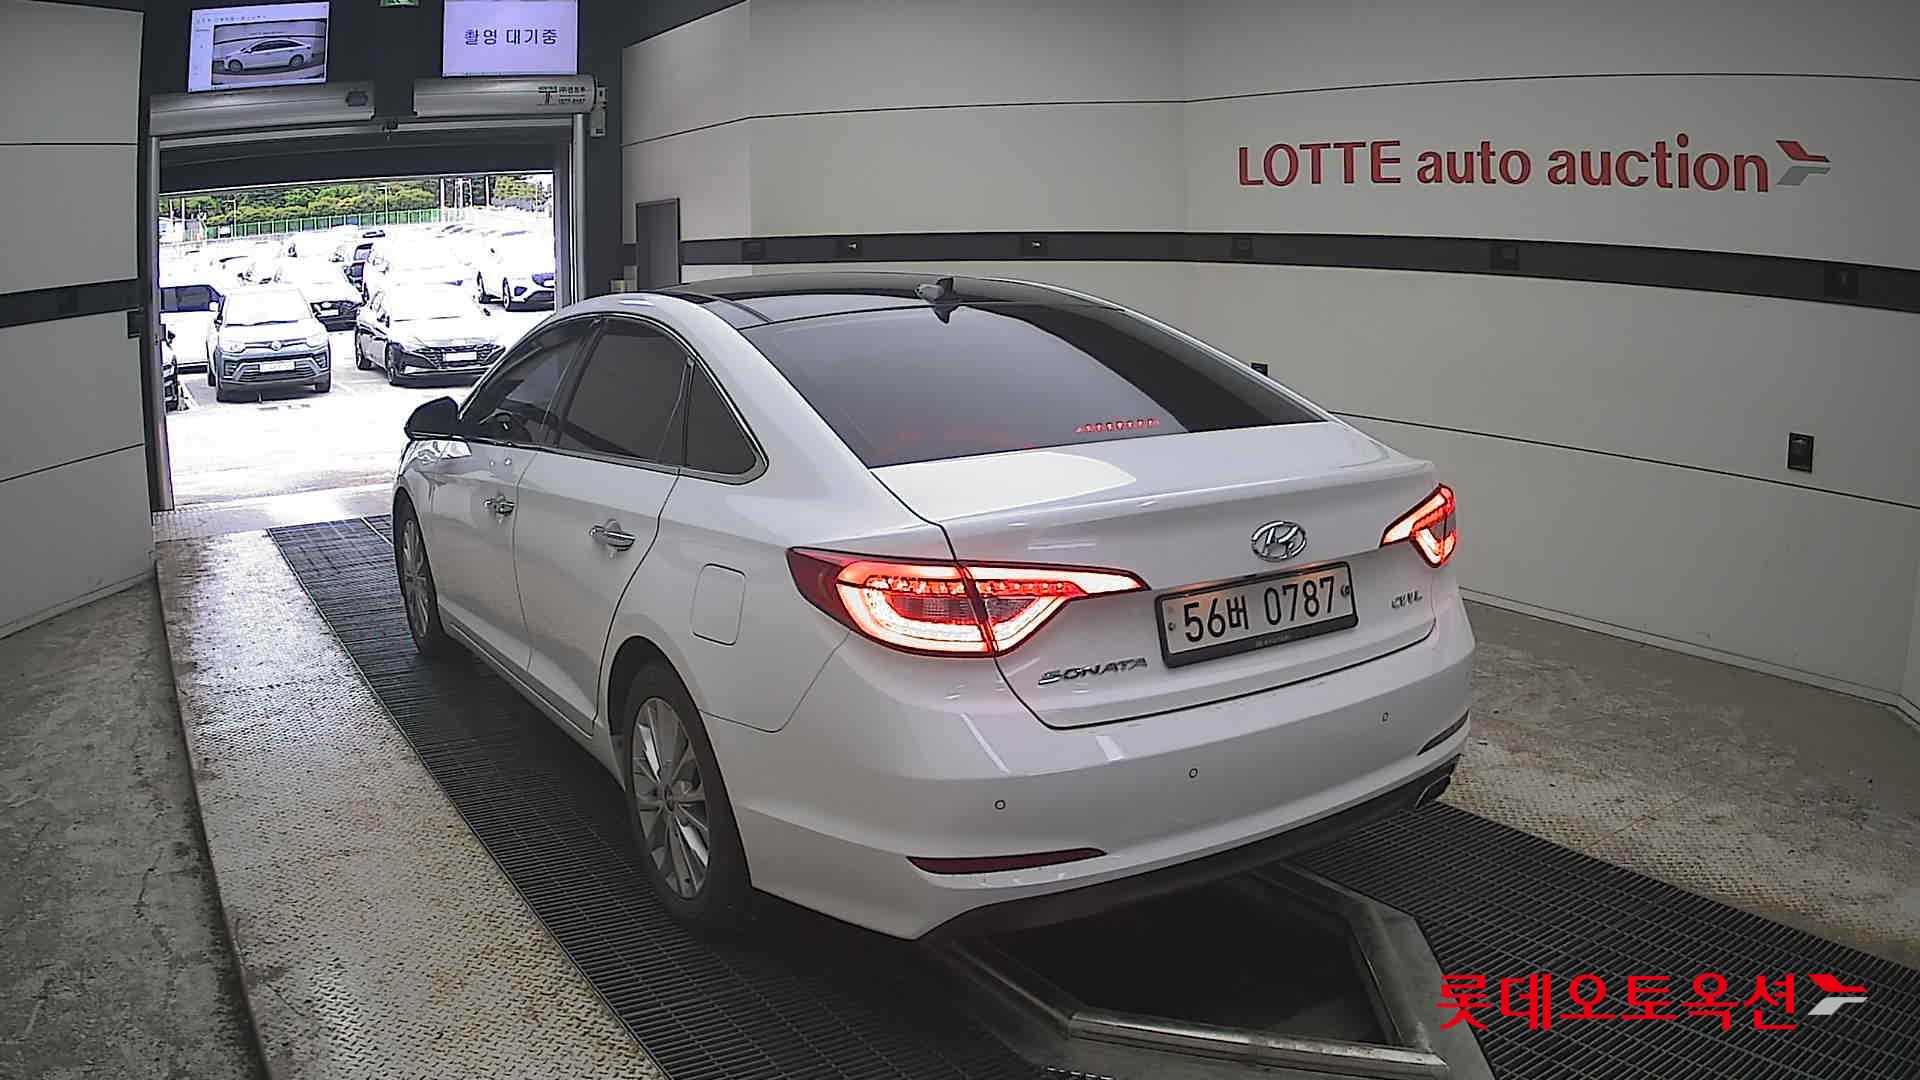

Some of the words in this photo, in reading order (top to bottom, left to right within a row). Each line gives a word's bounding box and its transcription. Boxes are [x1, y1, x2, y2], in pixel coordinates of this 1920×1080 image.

[506, 28, 558, 46] 대기중
[1238, 140, 1401, 187] LOTTE
[1416, 140, 1531, 185] auto
[1547, 133, 1769, 193] auction
[1183, 594, 1250, 643] 56버
[1263, 575, 1336, 626] 0787
[1037, 656, 1148, 686] SONATA
